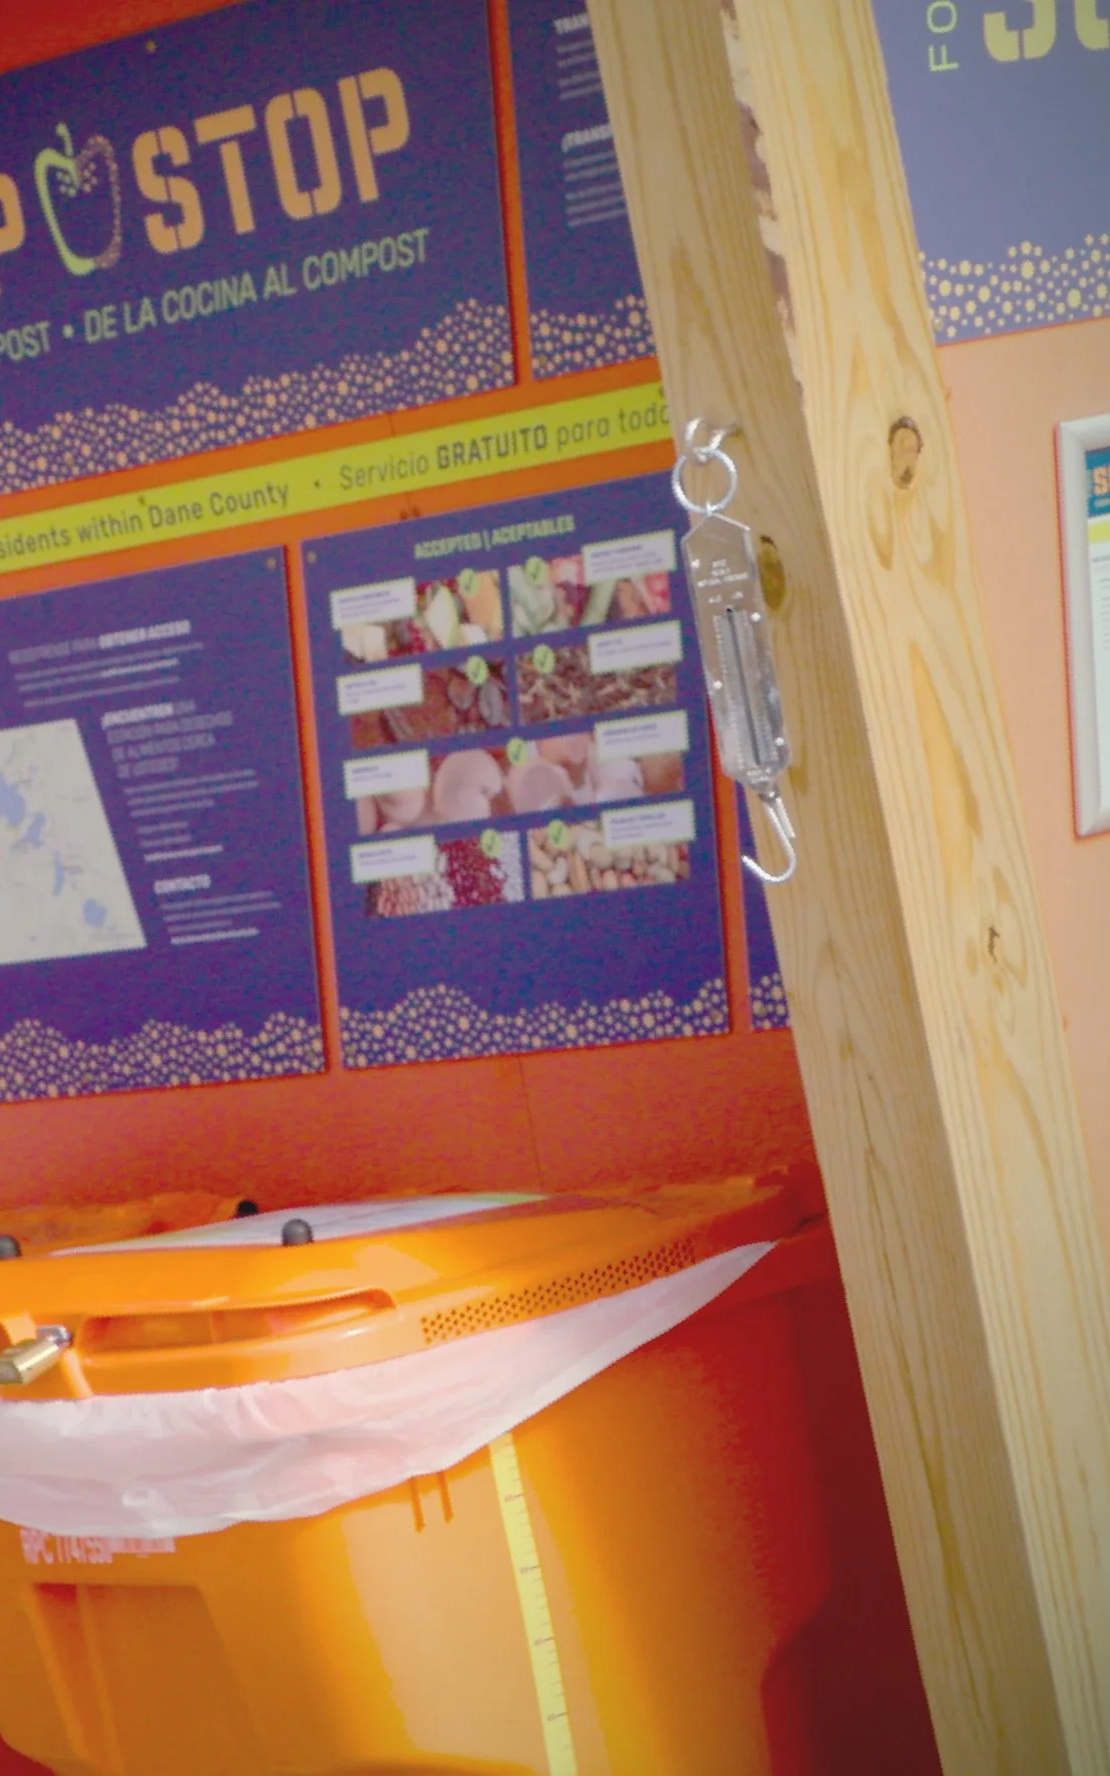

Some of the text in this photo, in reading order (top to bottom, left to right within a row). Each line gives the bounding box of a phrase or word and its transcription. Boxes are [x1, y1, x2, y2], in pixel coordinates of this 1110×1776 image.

[132, 67, 411, 254] STOP
[84, 304, 119, 343] DE
[123, 297, 158, 334] LA
[161, 272, 258, 324] COCINA
[263, 262, 298, 301] AL
[302, 228, 430, 291] COMPOST
[76, 510, 143, 543] within
[148, 501, 203, 530] Dane
[210, 481, 289, 516] County
[339, 452, 430, 491] Servicio
[437, 423, 548, 470] GRATUITO
[556, 417, 610, 454] para
